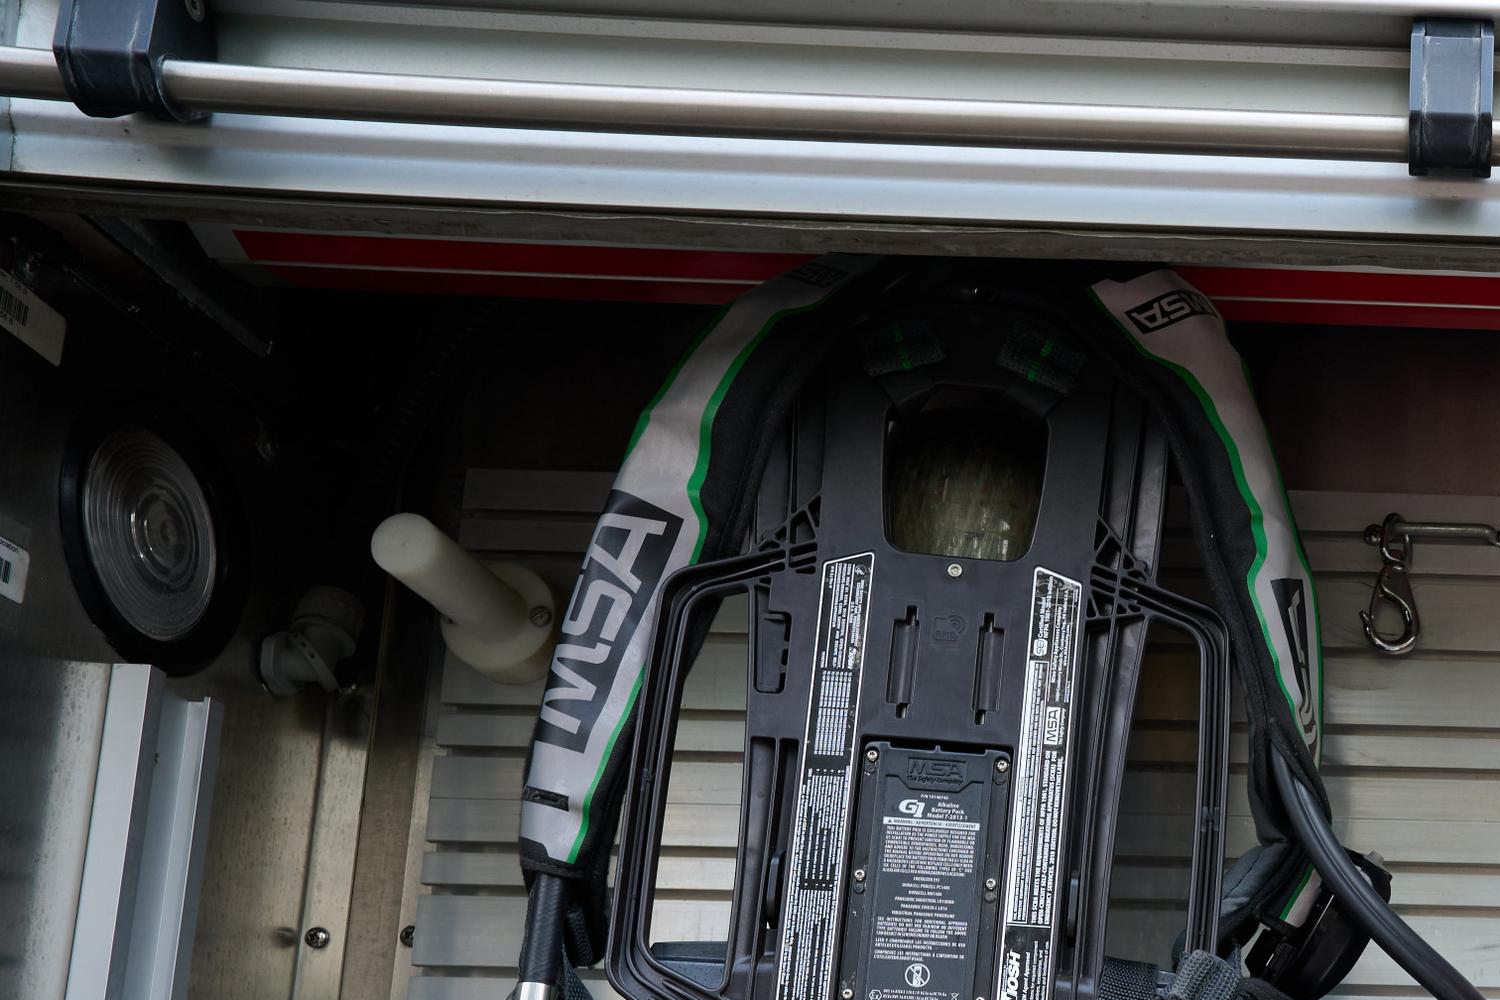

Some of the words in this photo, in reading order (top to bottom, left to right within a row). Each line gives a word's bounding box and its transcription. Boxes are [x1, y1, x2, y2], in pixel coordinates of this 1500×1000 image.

[540, 512, 667, 734] MSA
[1046, 709, 1058, 742] MSA
[898, 799, 926, 818] G1
